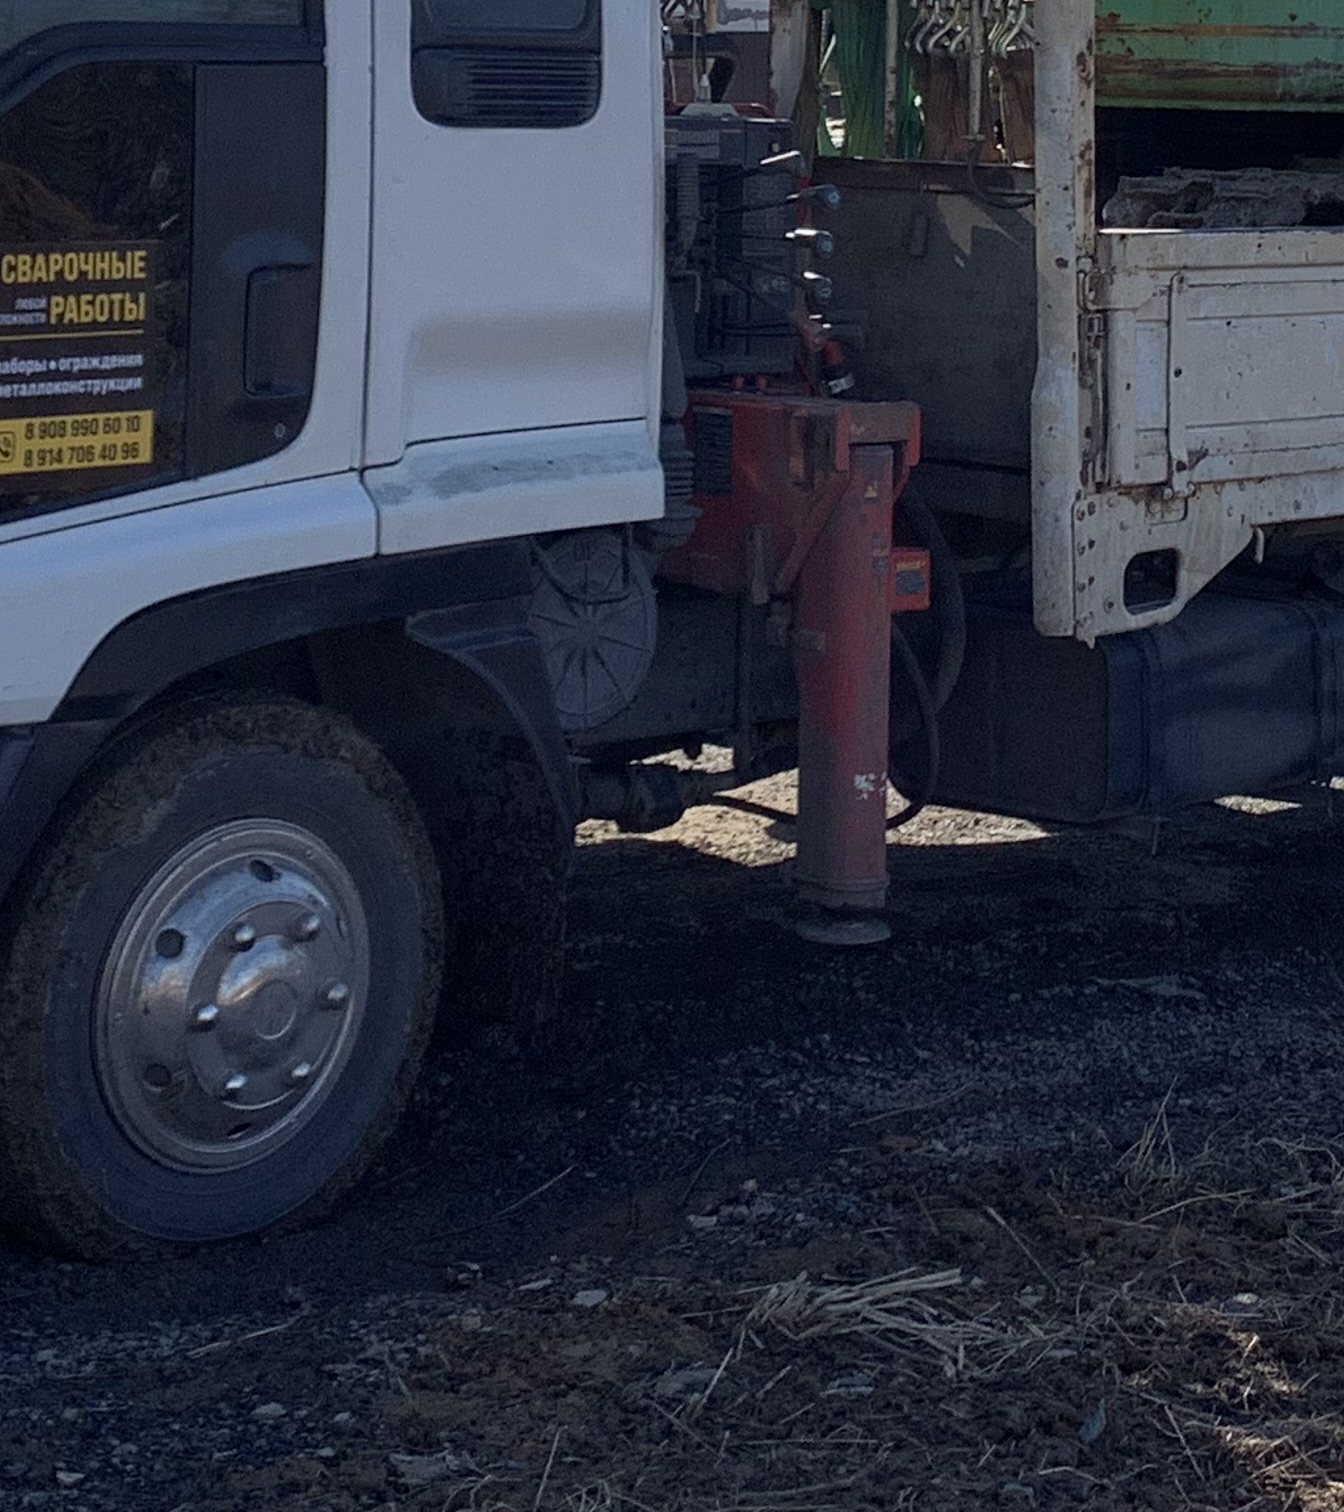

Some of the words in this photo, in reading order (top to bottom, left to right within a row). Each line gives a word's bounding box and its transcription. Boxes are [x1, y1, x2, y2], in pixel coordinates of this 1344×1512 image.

[1, 250, 147, 284] СВАРОЧНЫЕ
[49, 291, 146, 325] РАБОТЫ
[58, 354, 144, 372] ограждения
[24, 422, 34, 440] 8
[38, 420, 67, 439] 908
[70, 418, 99, 437] 990
[102, 416, 122, 435] 60
[125, 415, 141, 433] 10
[24, 449, 33, 468] 8
[36, 447, 64, 467] 914
[67, 445, 96, 464] 706
[98, 443, 118, 461] 40
[121, 441, 140, 459] 96
